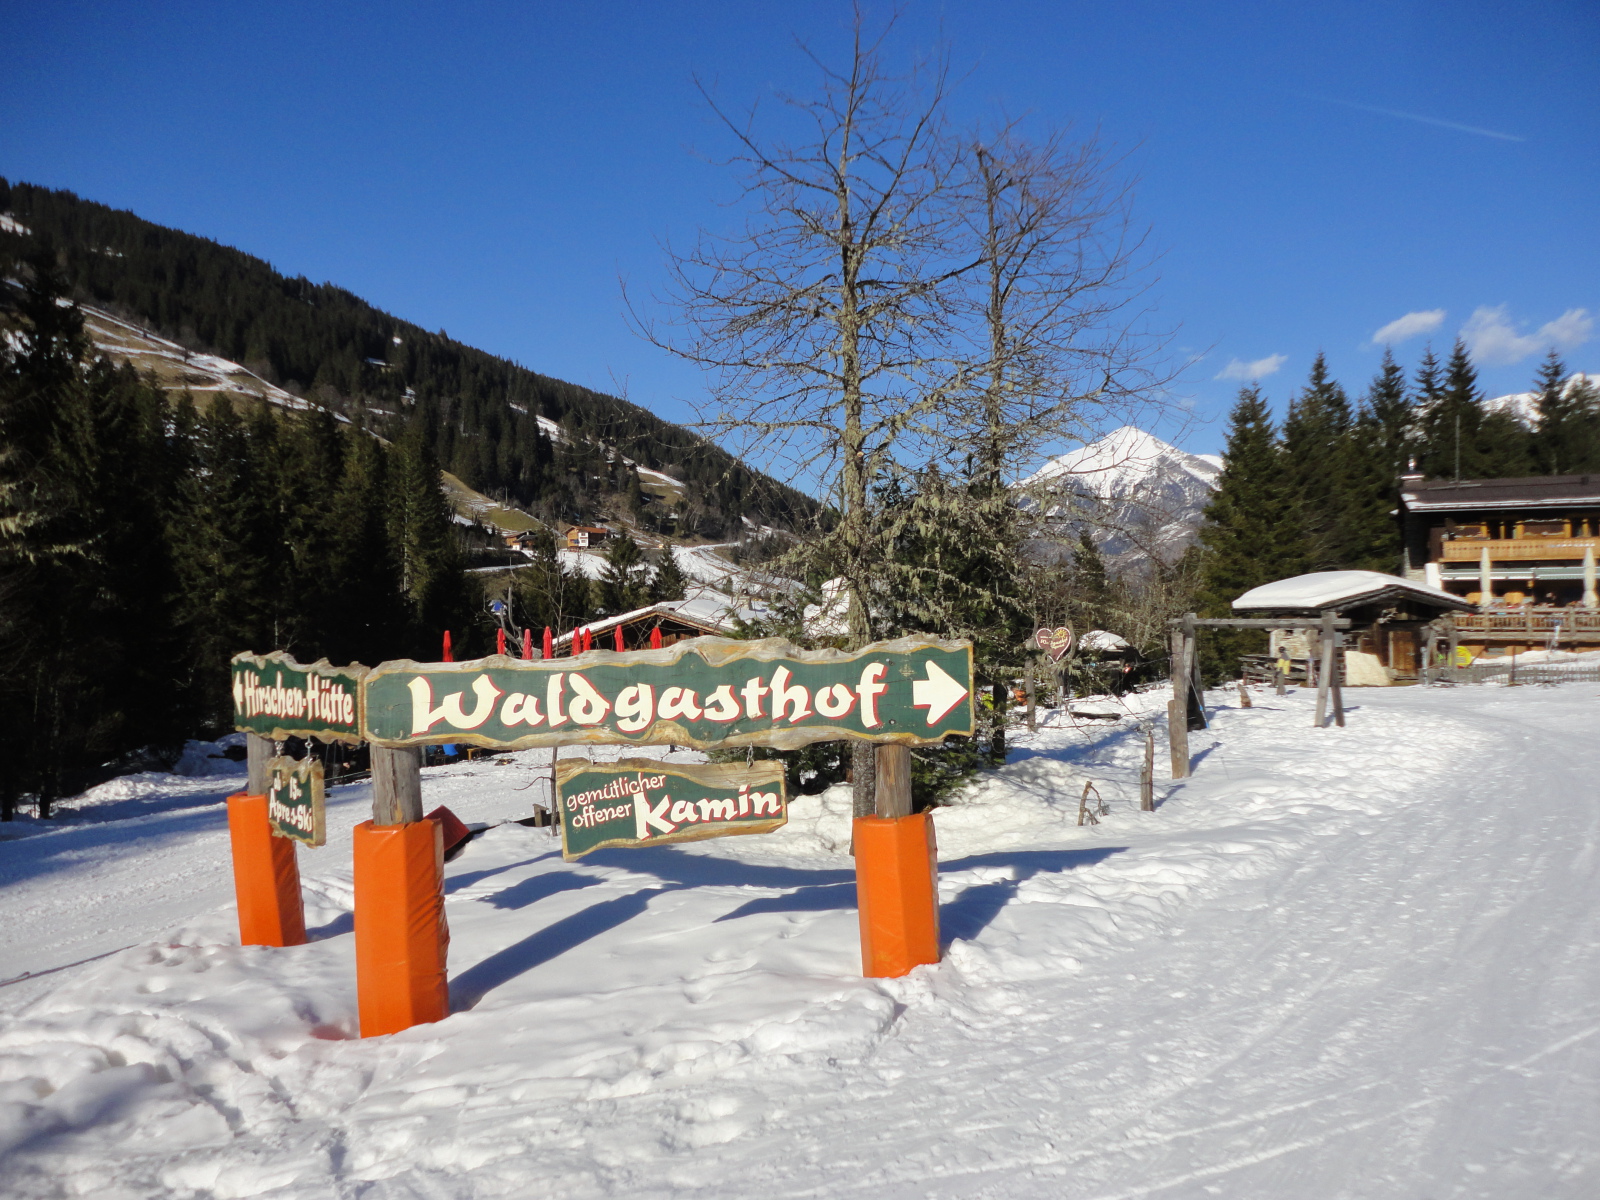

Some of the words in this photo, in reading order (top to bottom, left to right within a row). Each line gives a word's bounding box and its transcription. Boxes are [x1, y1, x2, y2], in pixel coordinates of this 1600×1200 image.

[244, 669, 354, 726] Hirschen-Hütte
[407, 663, 888, 736] Waldgasthof
[567, 772, 666, 811] gemütlicher
[572, 803, 632, 828] offener
[633, 784, 783, 841] Kamin
